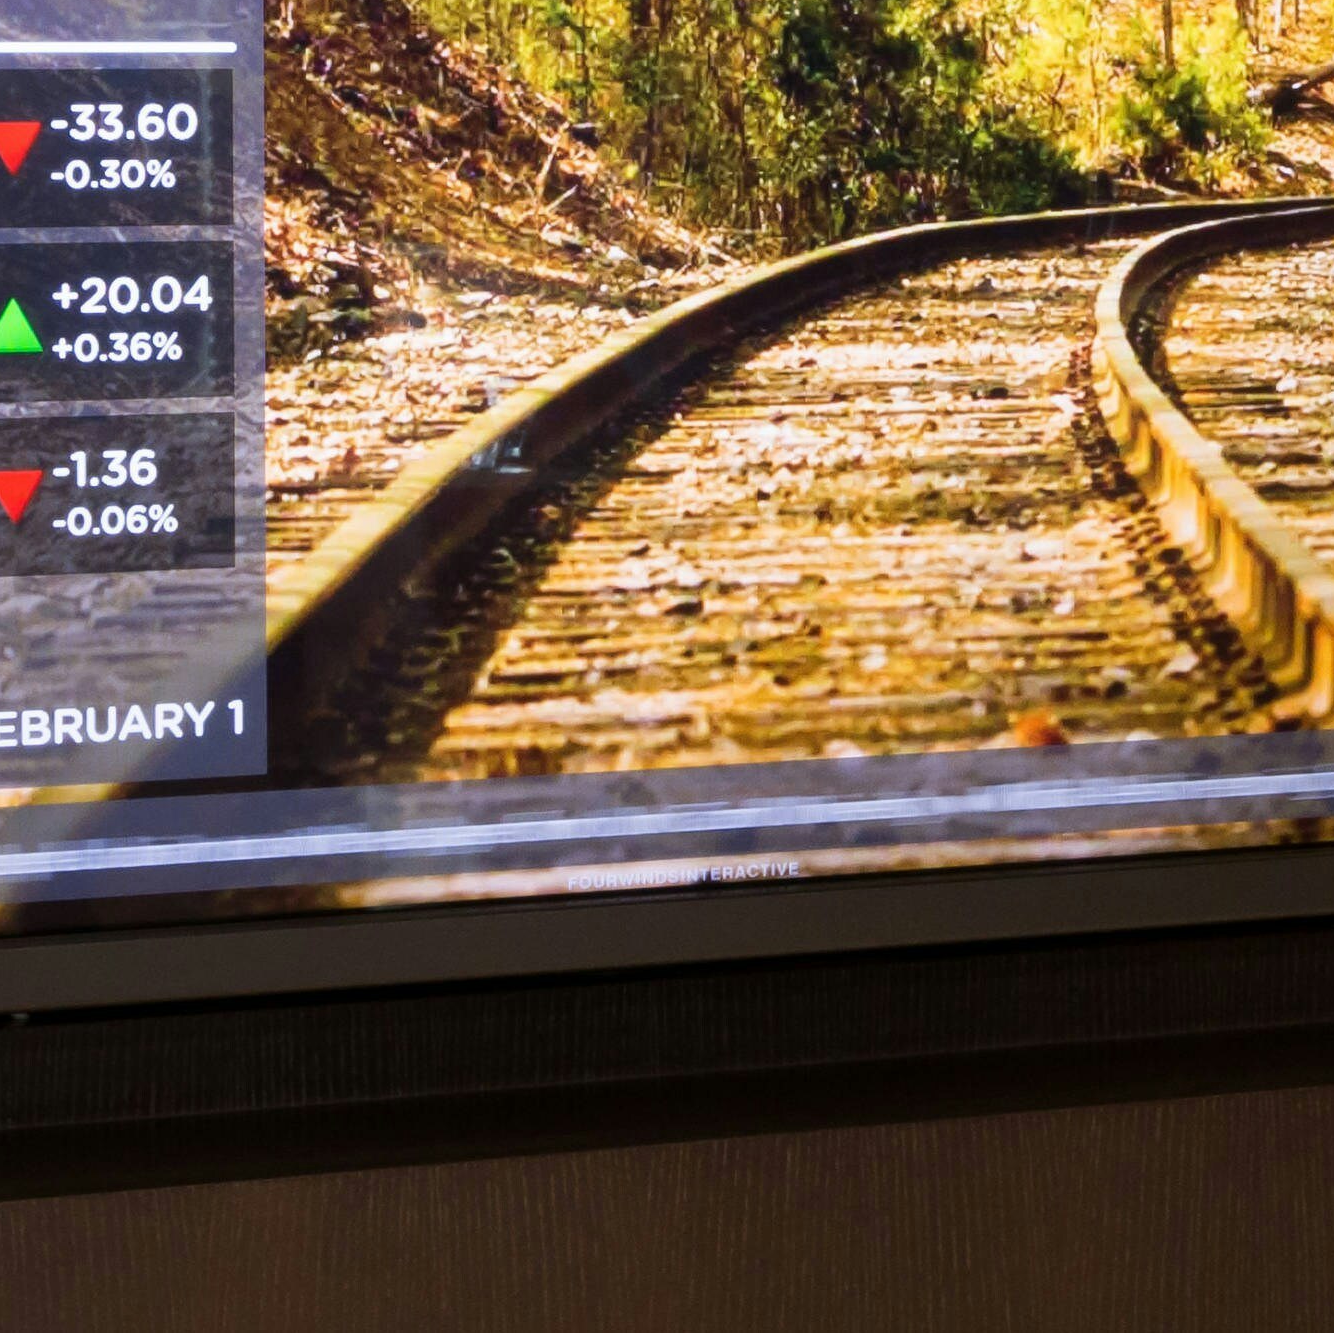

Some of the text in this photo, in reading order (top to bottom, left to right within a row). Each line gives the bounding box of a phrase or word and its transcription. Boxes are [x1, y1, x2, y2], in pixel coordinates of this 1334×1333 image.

[50, 103, 198, 141] -33.60
[50, 159, 177, 190] -0.30%
[51, 274, 213, 314] +20.04
[51, 331, 183, 363] +0.36%
[52, 448, 158, 487] -1.36
[52, 504, 180, 538] -0.06%
[227, 699, 245, 735] 1
